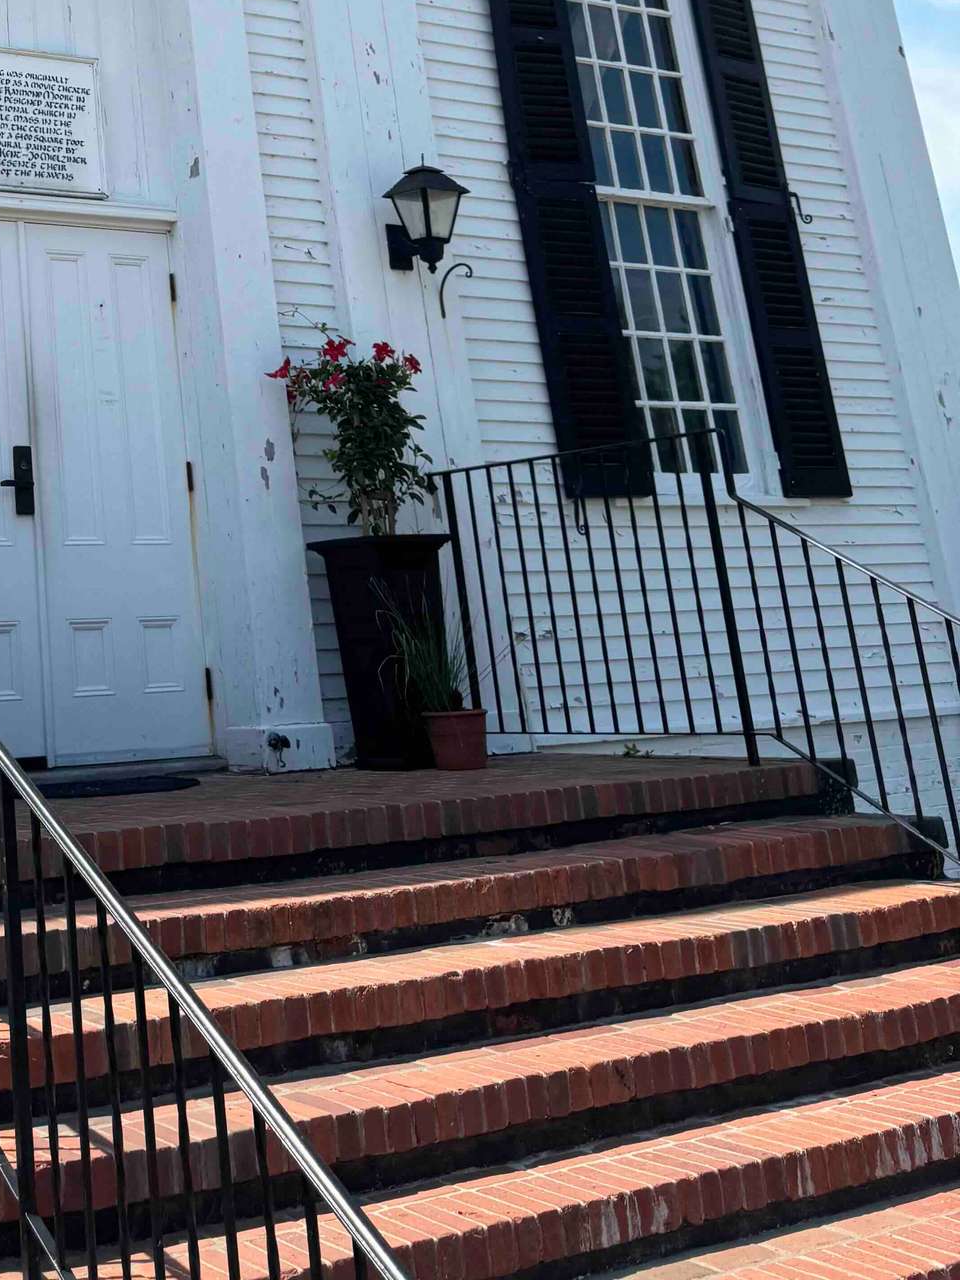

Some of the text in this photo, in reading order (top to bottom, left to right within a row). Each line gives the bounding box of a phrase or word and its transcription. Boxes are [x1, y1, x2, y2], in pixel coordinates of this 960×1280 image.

[25, 73, 68, 84] ORIGINALLY
[5, 86, 42, 97] RAYMOND
[43, 91, 73, 101] MOORE
[31, 82, 56, 90] MOVIE
[58, 85, 90, 95] THEATRE
[4, 96, 42, 106] DESIGNED
[45, 101, 69, 109] AFTER
[33, 109, 64, 117] CHURCH
[29, 126, 62, 135] CEILING
[34, 135, 63, 144] SQUARE
[27, 143, 63, 152] PAINTED
[0, 148, 21, 158] KENT
[40, 162, 67, 171] THEIR
[1, 168, 12, 177] OF
[35, 171, 73, 181] HEAVENS
